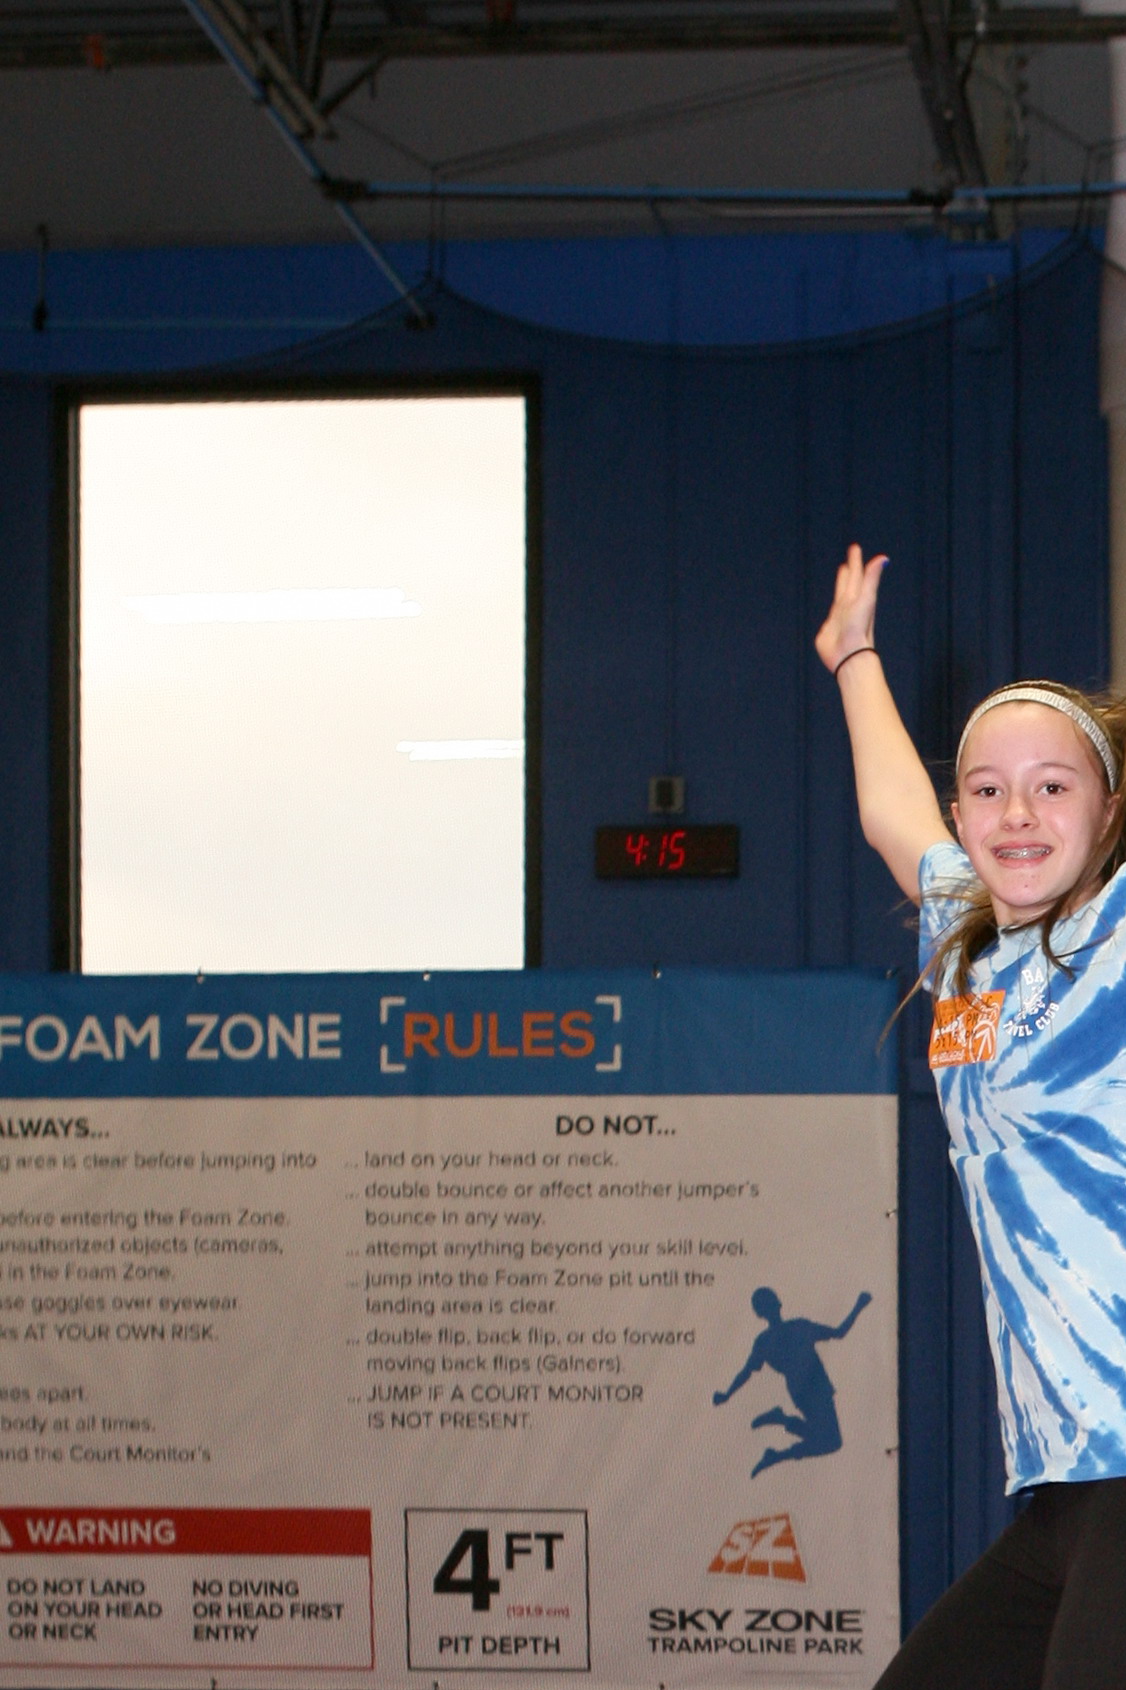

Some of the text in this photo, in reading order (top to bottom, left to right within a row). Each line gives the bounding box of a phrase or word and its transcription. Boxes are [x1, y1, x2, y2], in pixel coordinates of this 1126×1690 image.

[625, 830, 685, 870] 4:15
[0, 1014, 161, 1062] FOAM
[186, 1013, 341, 1060] ZONE
[556, 1115, 594, 1136] DO
[16, 1153, 56, 1168] area
[62, 1151, 77, 1168] is
[83, 1150, 126, 1168] clear
[134, 1150, 194, 1168] before
[201, 1150, 275, 1172] jumping
[281, 1150, 317, 1168] into
[365, 1150, 405, 1168] land
[411, 1153, 435, 1168] on
[440, 1153, 481, 1171] your
[489, 1151, 536, 1167] head
[543, 1153, 559, 1167] or
[568, 1151, 619, 1167] neck.
[365, 1180, 430, 1199] double
[437, 1180, 508, 1198] bounce
[514, 1183, 533, 1198] or
[540, 1179, 592, 1198] affect
[599, 1179, 672, 1197] another
[678, 1179, 760, 1200] jumper's
[60, 1208, 137, 1229] entering
[143, 1207, 173, 1226] the
[179, 1207, 231, 1227] Foam
[365, 1208, 546, 1228] bounce in any way.
[0, 1235, 283, 1255] nauthorized objects (cameras,
[366, 1239, 437, 1259] attempt
[444, 1239, 524, 1259] anything
[531, 1239, 602, 1259] beyond
[608, 1242, 649, 1259] your
[656, 1239, 693, 1256] skill
[8, 1262, 24, 1281] in
[30, 1262, 59, 1281] the
[65, 1262, 116, 1281] Foam
[366, 1270, 412, 1290] jump
[418, 1270, 453, 1286] into
[460, 1269, 488, 1286] the
[496, 1268, 547, 1287] Foam
[554, 1268, 602, 1287] Zone
[610, 1270, 633, 1288] pit
[639, 1270, 679, 1287] until
[685, 1270, 715, 1287] the
[32, 1295, 105, 1315] goggles
[112, 1297, 150, 1311] over
[366, 1297, 436, 1316] landing
[441, 1300, 483, 1314] area
[489, 1298, 503, 1314] is
[24, 1323, 48, 1341] AT
[55, 1322, 110, 1341] YOUR
[116, 1323, 165, 1341] OWN
[366, 1327, 432, 1345] double
[476, 1327, 521, 1345] back
[566, 1331, 584, 1345] or
[592, 1327, 617, 1345] do
[623, 1327, 696, 1345] forward
[367, 1355, 436, 1374] moving
[441, 1354, 486, 1371] back
[493, 1354, 531, 1374] flips
[367, 1384, 421, 1402] JUMP
[428, 1385, 444, 1401] IF
[450, 1385, 464, 1401] A
[471, 1384, 541, 1402] COURT
[548, 1384, 644, 1401] MONITOR
[53, 1417, 69, 1432] at
[75, 1415, 96, 1432] all
[368, 1411, 385, 1429] IS
[391, 1411, 433, 1429] NOT
[35, 1446, 63, 1462] the
[70, 1445, 120, 1462] Court
[127, 1445, 211, 1463] Monitor's
[25, 1517, 177, 1546] WARNING
[433, 1527, 564, 1612] 4 FT
[7, 1578, 146, 1597] DO NOT LAND
[192, 1580, 300, 1599] NO DIVING
[8, 1601, 163, 1620] ON YOUR HEAD
[193, 1602, 346, 1621] OR HEAD FIRST
[650, 1607, 864, 1633] SKY ZONE
[8, 1623, 98, 1642] OR NECK
[194, 1625, 260, 1642] ENTRY
[439, 1635, 561, 1655] PIT DEPTH
[647, 1637, 864, 1656] TRAMPOLINE PARK
